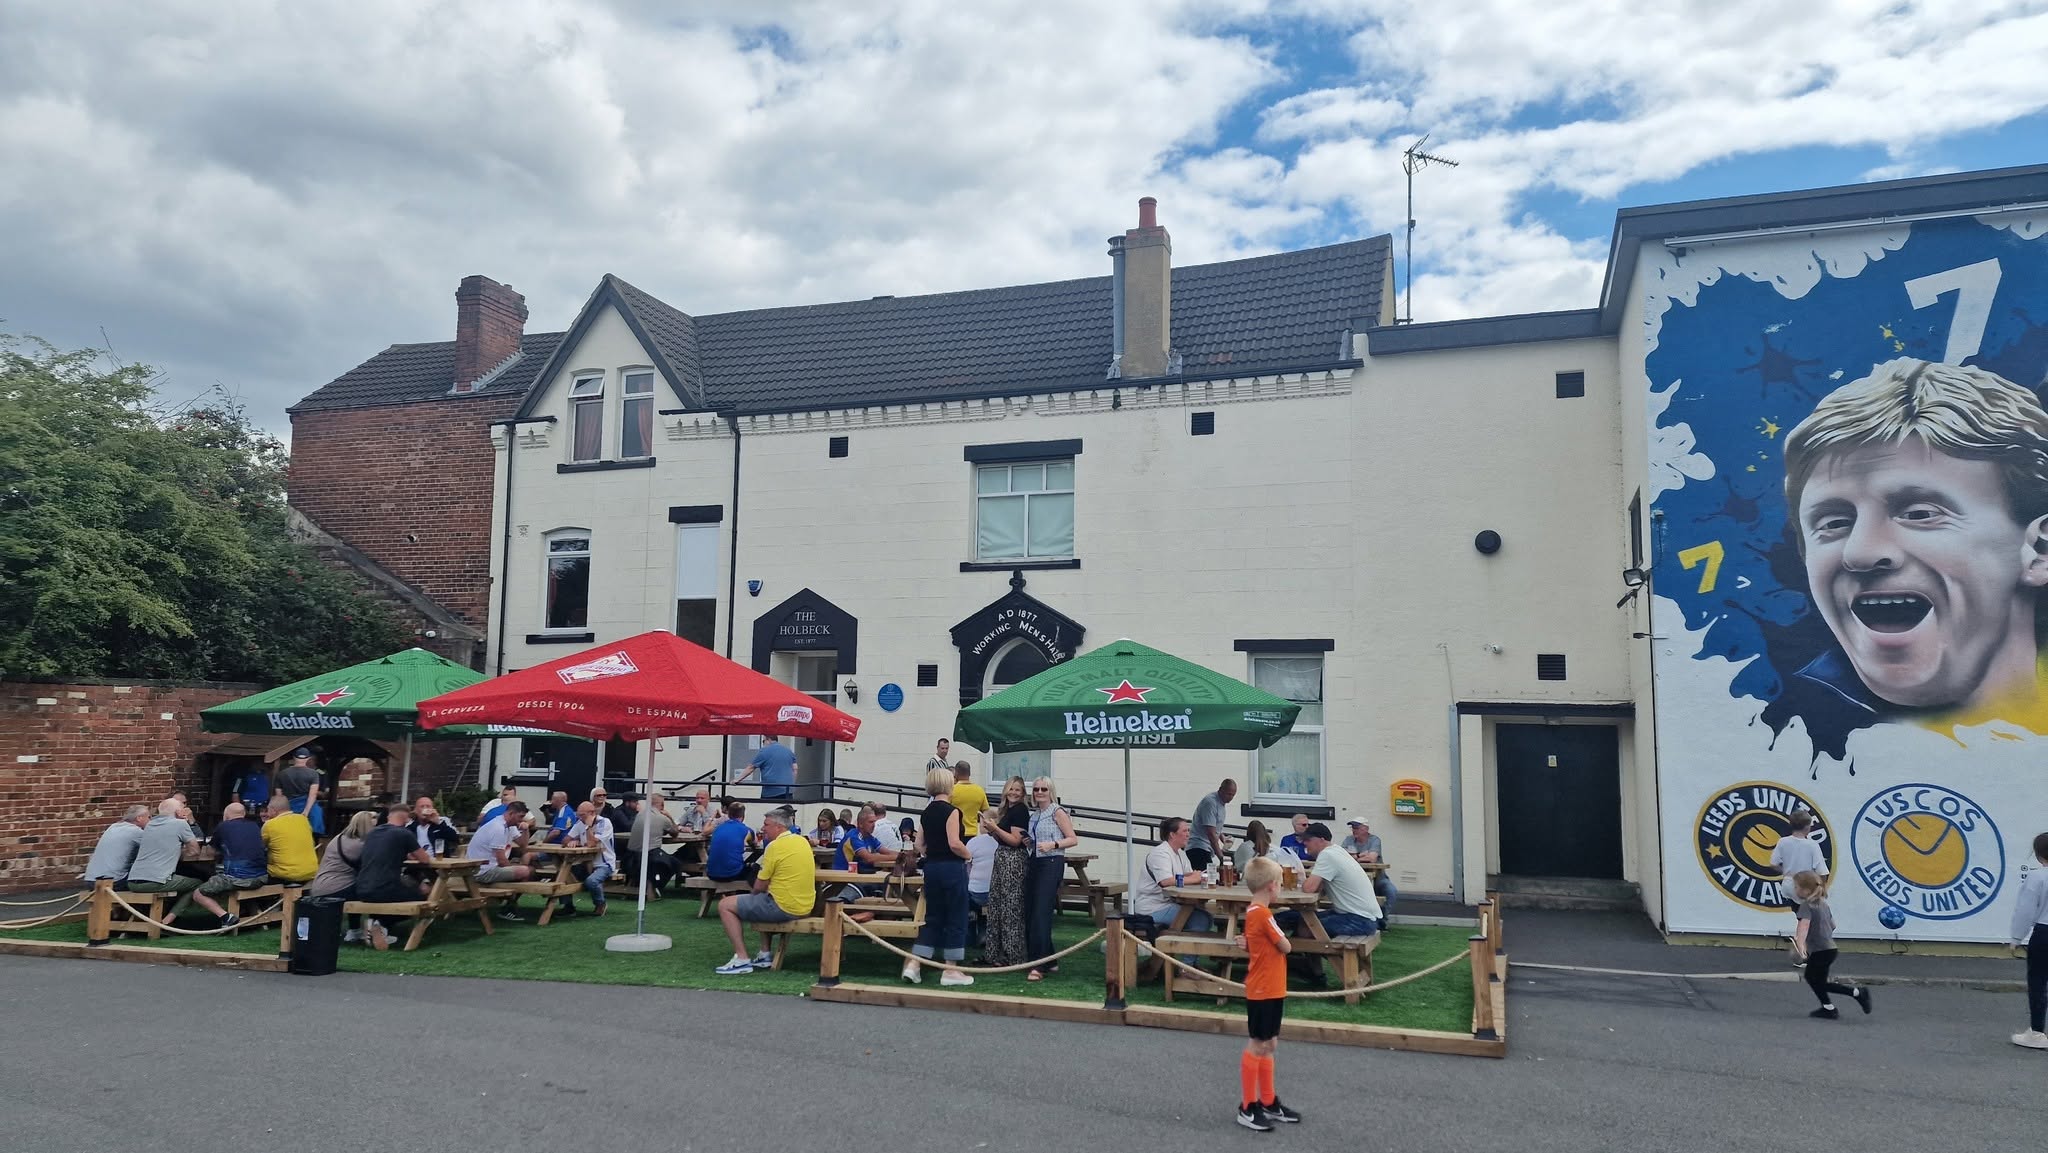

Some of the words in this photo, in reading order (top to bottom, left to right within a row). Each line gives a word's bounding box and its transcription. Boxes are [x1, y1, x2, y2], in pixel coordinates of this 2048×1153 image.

[1904, 257, 2002, 366] 7
[1677, 540, 1724, 594] 7
[780, 625, 831, 635] HOLBECK
[794, 611, 816, 621] THE
[1018, 609, 1037, 622] 1877
[1080, 667, 1137, 682] MALT
[1144, 669, 1214, 700] QUALITY
[267, 711, 355, 730] Heineken
[427, 710, 437, 718] LA
[440, 705, 485, 716] CERVEZA
[517, 700, 554, 709] DESDE
[558, 701, 585, 711] 1904
[628, 706, 641, 715] DE
[647, 708, 688, 720] ESPAÑA
[1701, 792, 1747, 837] LEEDS
[1864, 789, 1982, 832] LUSCOS
[1713, 864, 1784, 905] ATLAN
[1864, 860, 1913, 905] LEEDS
[1922, 866, 1995, 912] UNITED
